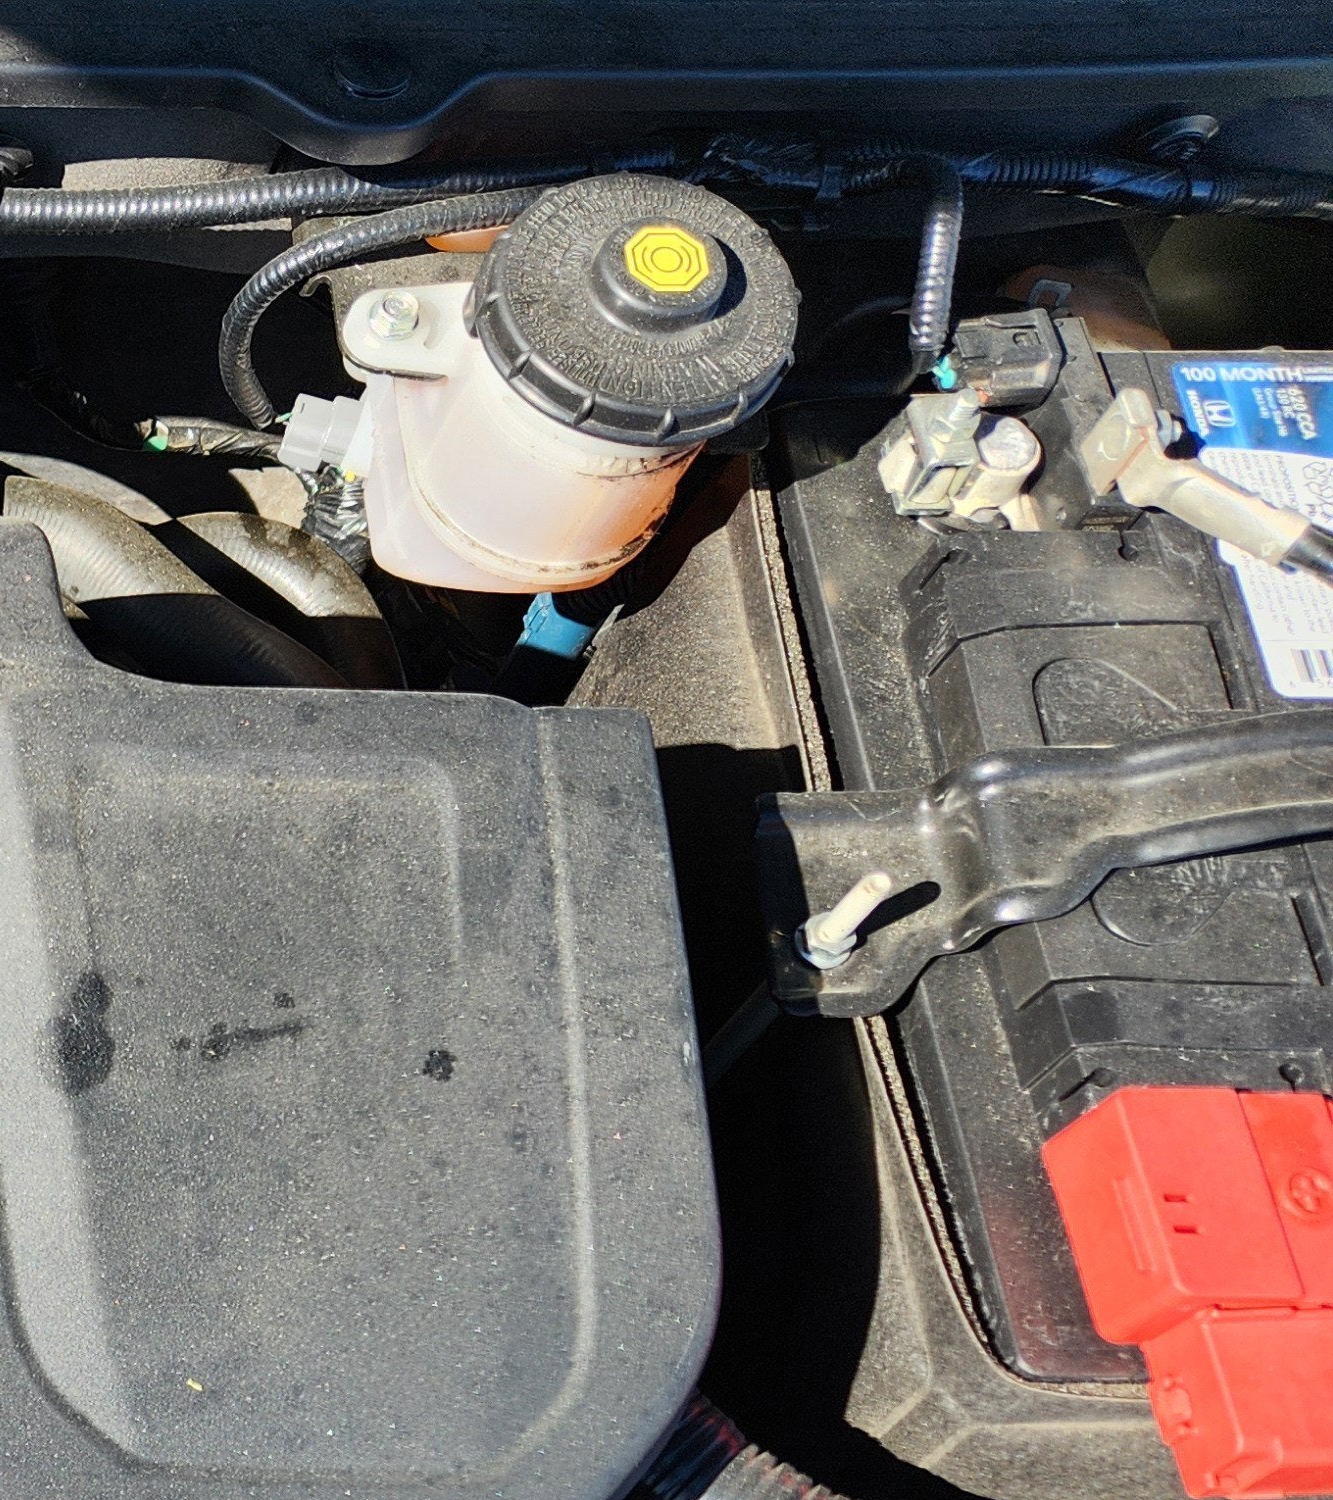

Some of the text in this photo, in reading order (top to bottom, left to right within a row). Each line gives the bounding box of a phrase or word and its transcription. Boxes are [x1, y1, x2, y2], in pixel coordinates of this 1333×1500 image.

[1180, 367, 1216, 382] 100
[1220, 367, 1303, 382] MONTH
[1187, 389, 1210, 437] HONDA
